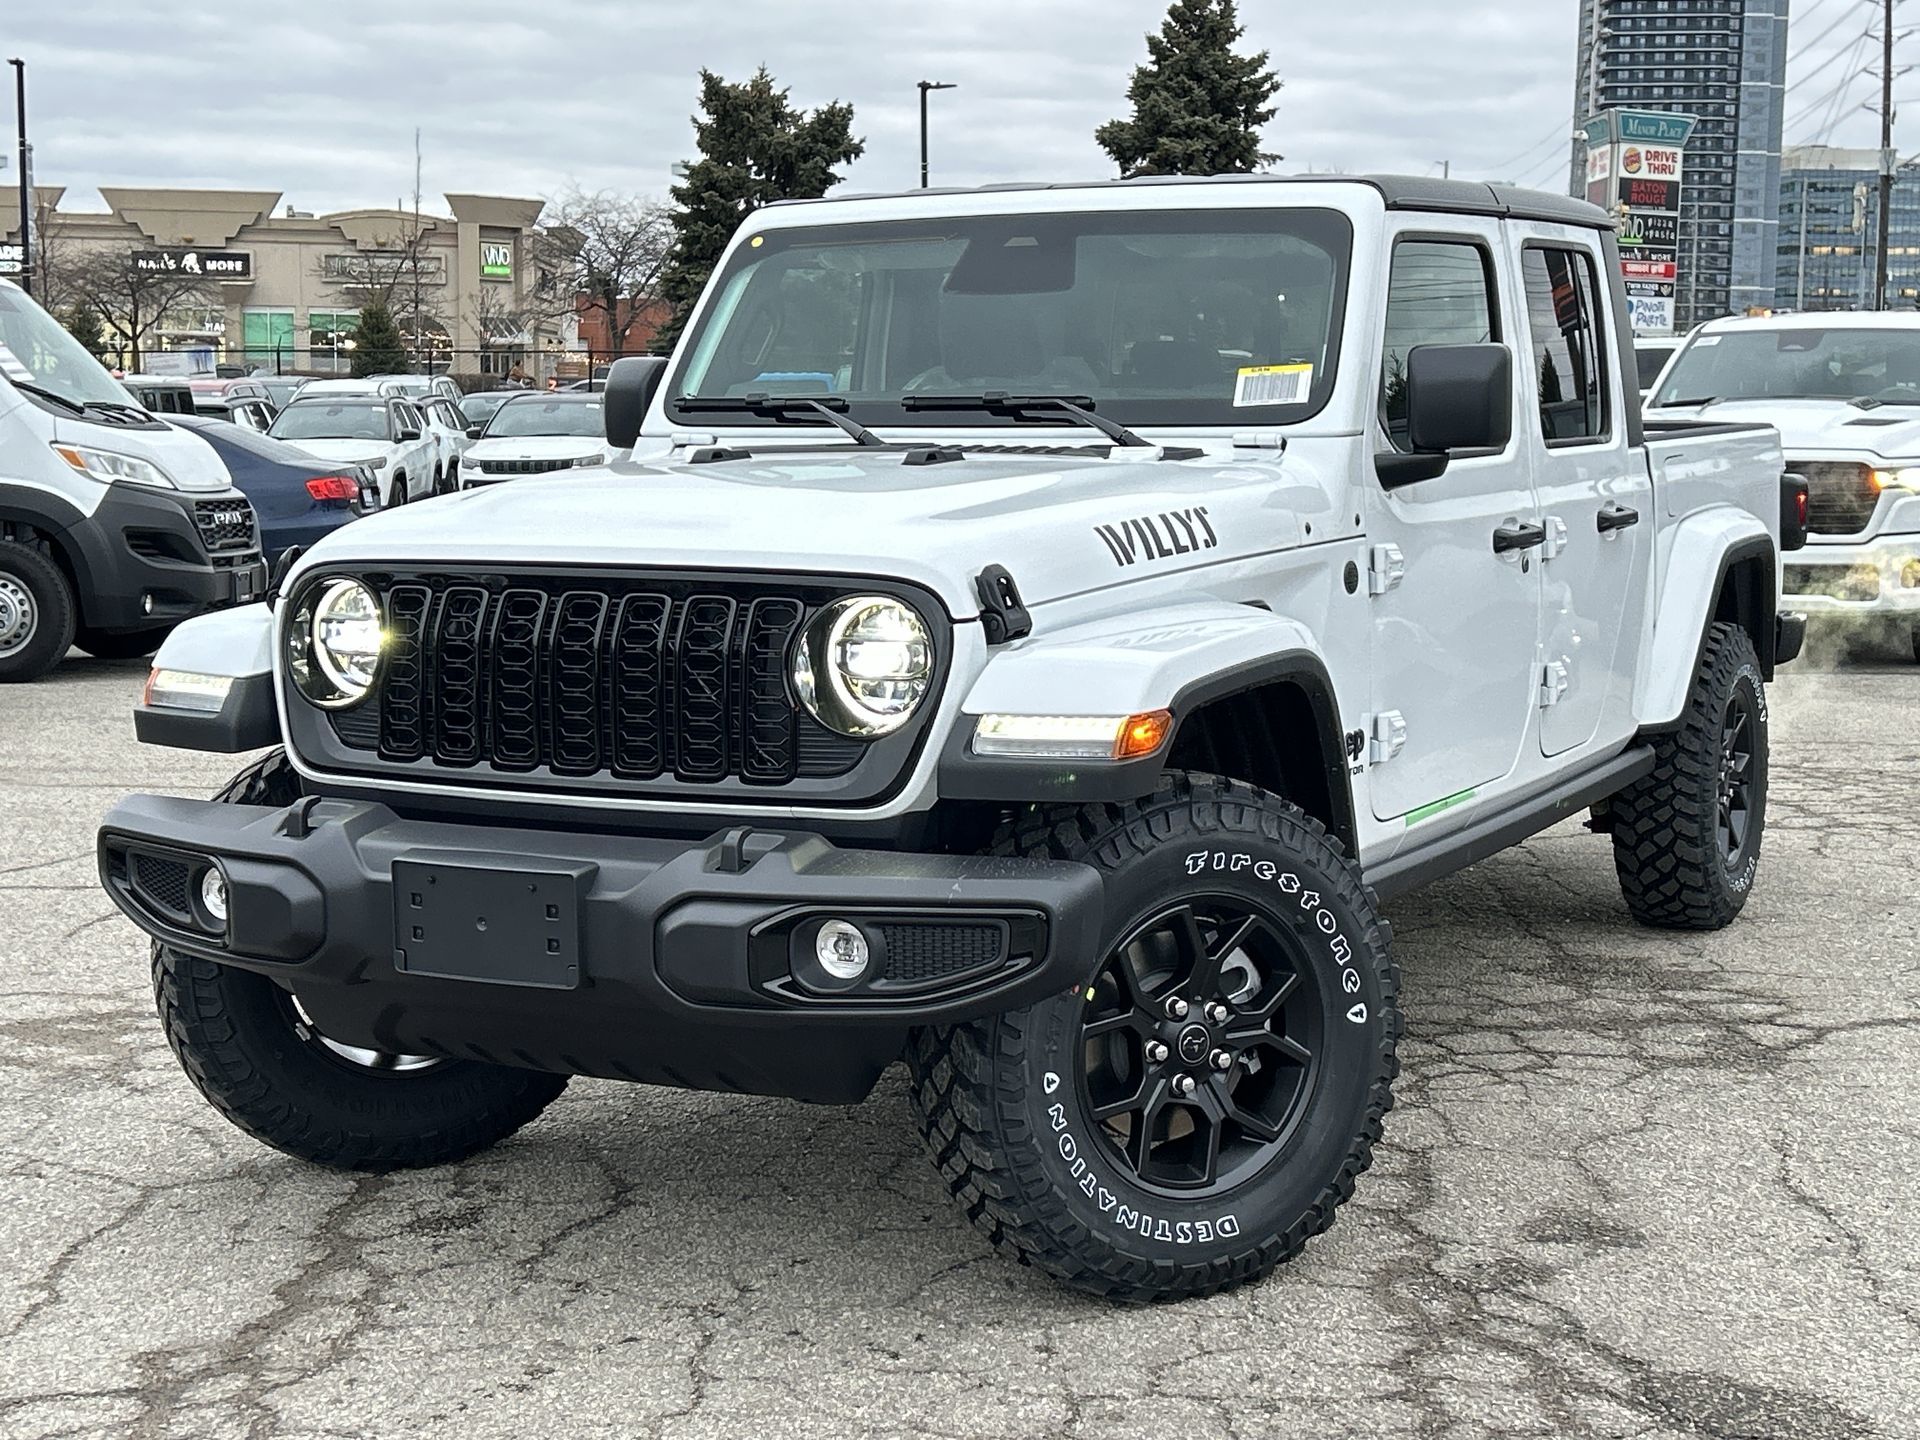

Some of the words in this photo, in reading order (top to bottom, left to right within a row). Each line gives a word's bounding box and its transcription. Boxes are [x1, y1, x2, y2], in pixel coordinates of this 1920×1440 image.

[1645, 149, 1678, 163] DRIVE
[1647, 162, 1676, 175] THRU
[1631, 192, 1667, 205] ROUGE
[205, 260, 243, 271] MORE
[1093, 506, 1217, 567] WILLYS
[1185, 851, 1361, 994] Firestone
[1048, 1103, 1240, 1243] DESTINATION
